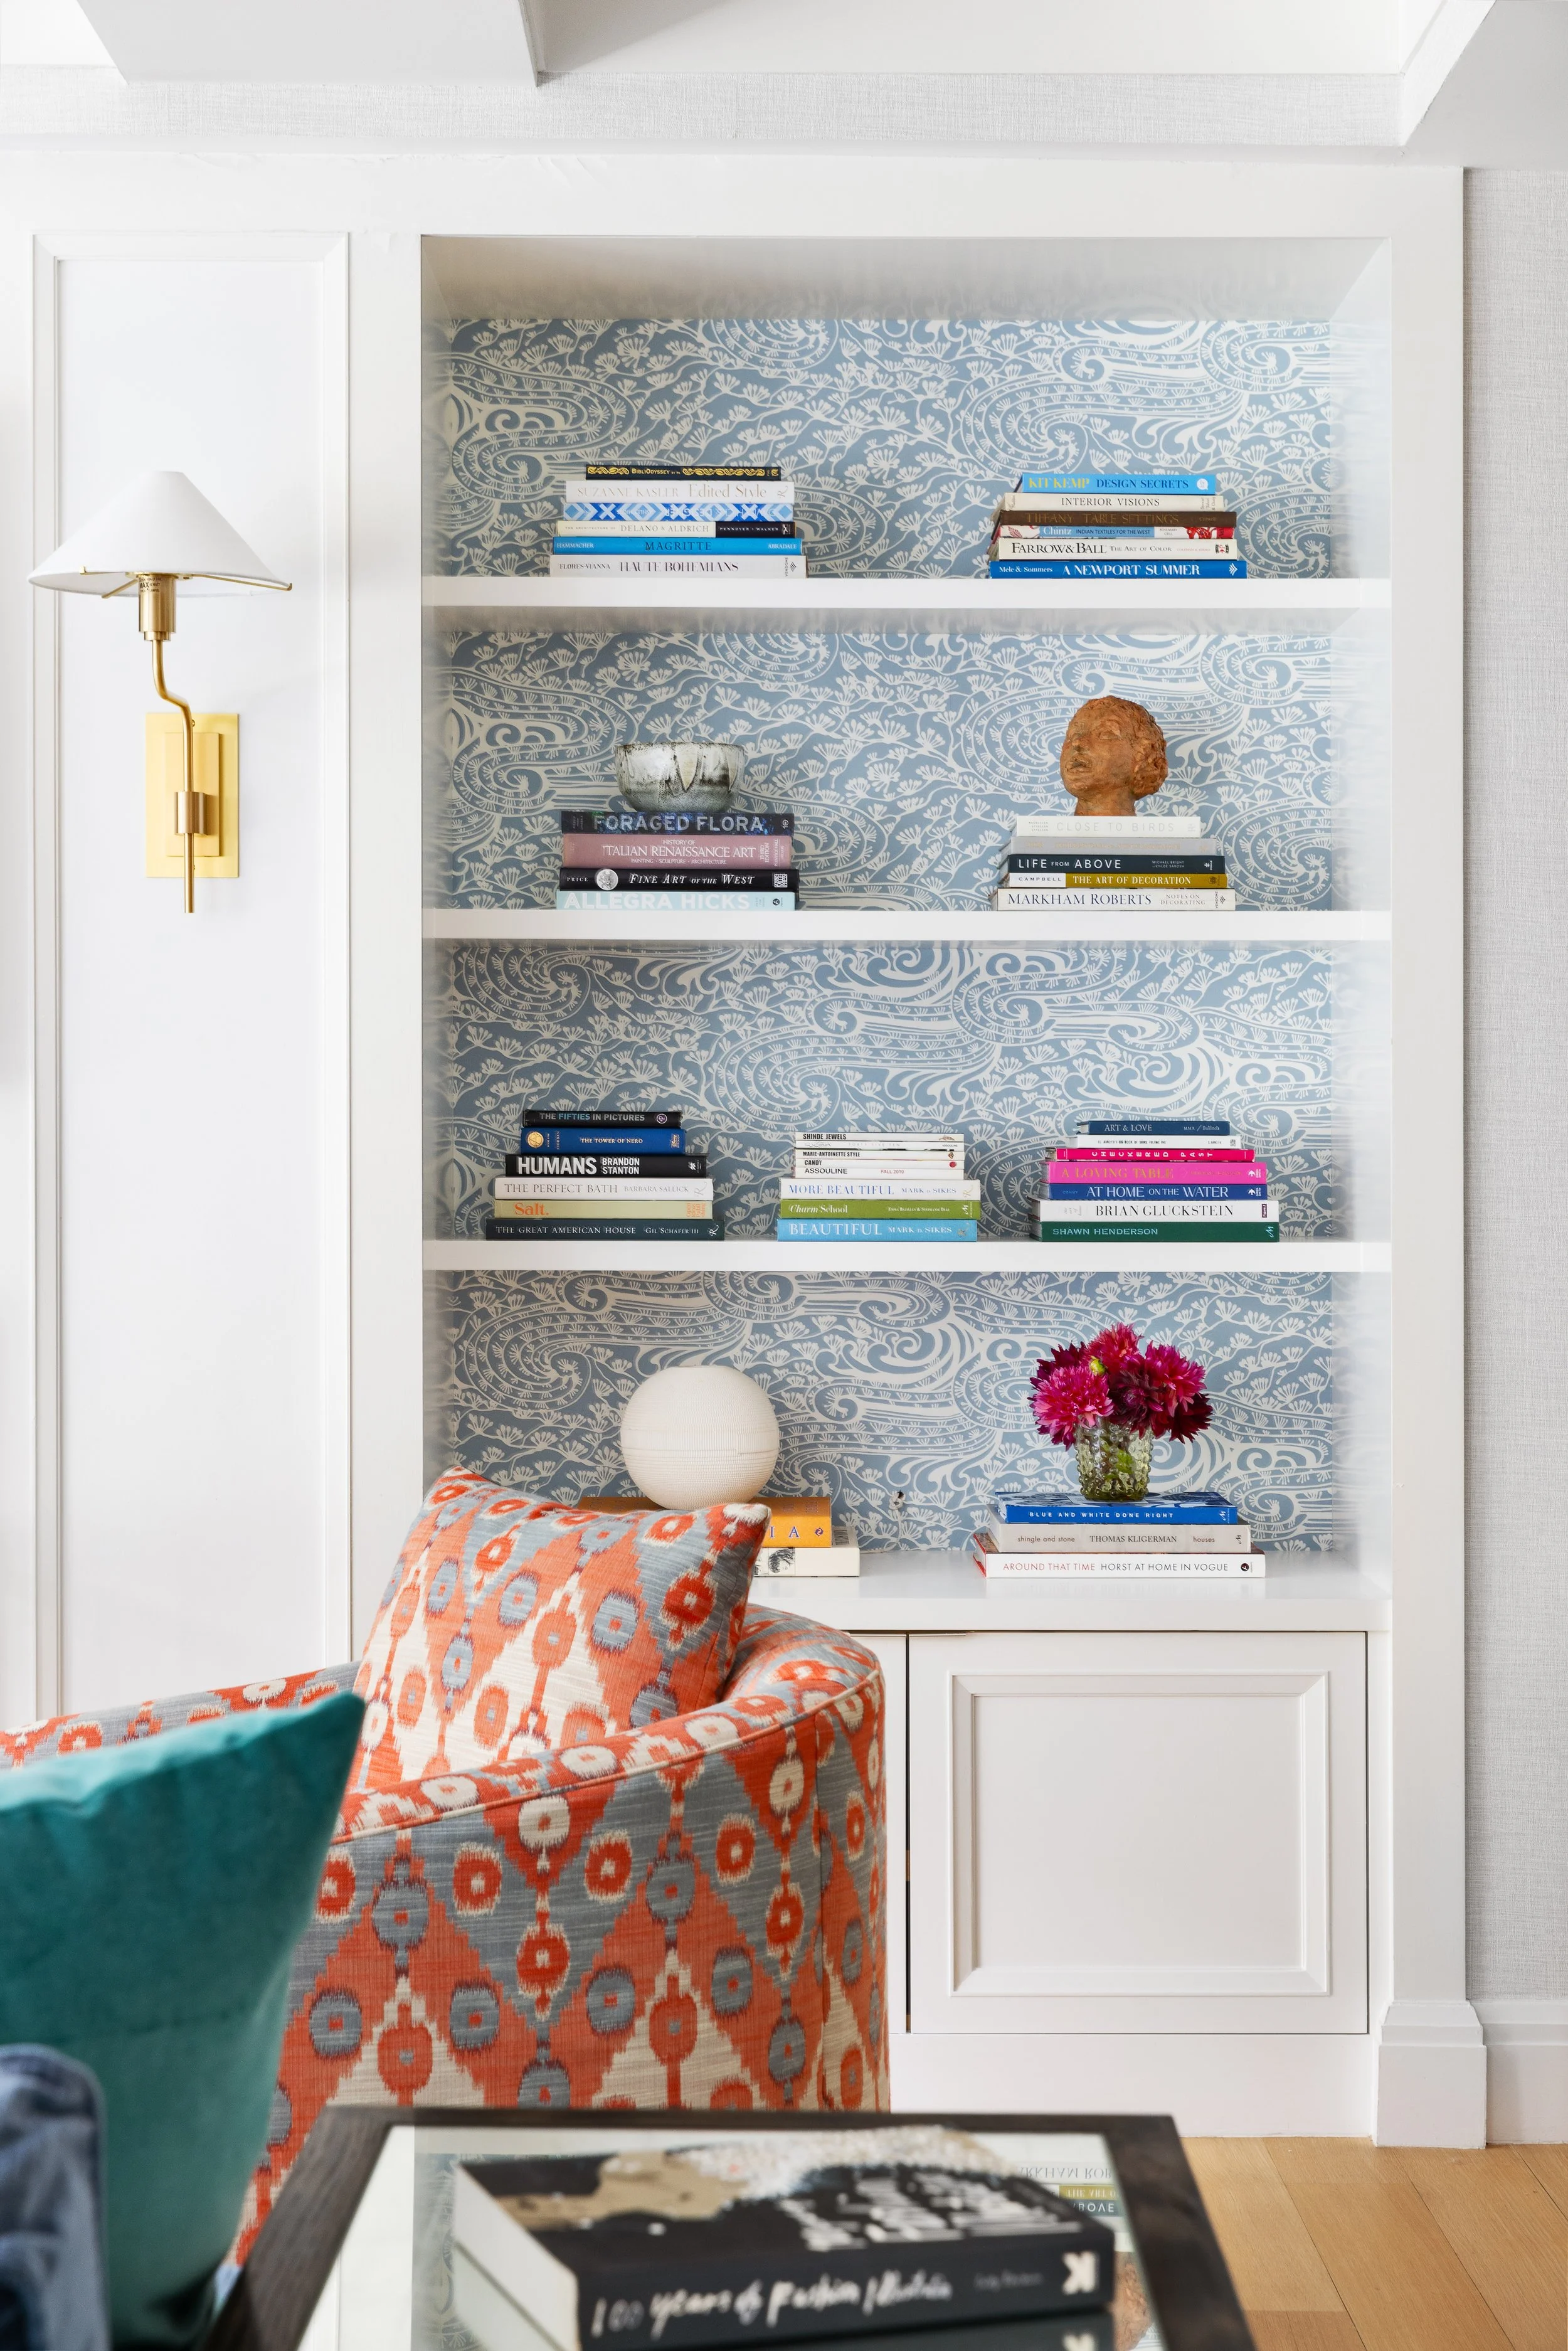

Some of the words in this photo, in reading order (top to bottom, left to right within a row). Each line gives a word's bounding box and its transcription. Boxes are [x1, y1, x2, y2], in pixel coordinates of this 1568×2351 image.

[1029, 477, 1051, 488] KIT
[1053, 477, 1089, 489] KEMP
[1097, 479, 1136, 488] DESIGN
[1140, 479, 1189, 489] SECRETS
[577, 487, 632, 497] SUZANNE
[636, 487, 679, 497] KASLER
[689, 484, 729, 497] Edited
[735, 484, 766, 498] Style
[1062, 497, 1111, 506] INTERIOR
[1117, 497, 1160, 506] VISIONS
[1025, 513, 1074, 523] TIFFANY
[1083, 513, 1117, 524] TABLE
[1121, 514, 1179, 524] SETTINGS
[1043, 526, 1071, 535] Chintz
[645, 541, 712, 551] MAGRITTE
[1012, 542, 1066, 553] FARROW
[1076, 542, 1106, 553] BALL
[619, 561, 660, 571] HAUTE
[665, 561, 739, 572] BOHEMIANS
[1062, 565, 1071, 575] A
[1074, 565, 1142, 575] NEWPORT
[1145, 565, 1200, 575] SUMMER
[594, 815, 689, 831] FORAGED
[696, 816, 764, 832] FLORA
[1057, 822, 1099, 831] CLOSE
[1108, 822, 1123, 832] TO
[1132, 822, 1174, 832] BIRDS
[602, 845, 647, 857] ITALIAN
[651, 846, 730, 857] RENAISSANCE
[733, 847, 756, 858] ART
[1019, 859, 1047, 868] LIFE
[1074, 859, 1121, 869] ABOVE
[1073, 876, 1091, 884] THE
[1095, 876, 1113, 884] ART
[1116, 876, 1129, 884] OF
[1132, 876, 1191, 884] DECORATION
[564, 892, 673, 909] ALLEGRA
[681, 893, 751, 910] HICKS
[1008, 893, 1085, 905] MARKHAM
[1091, 893, 1152, 905] ROBERTS
[517, 1157, 597, 1175] HUMANS
[602, 1157, 640, 1166] BRANDON
[602, 1167, 640, 1175] STANTON
[1061, 1168, 1069, 1178] A
[1074, 1168, 1128, 1179] LOVING
[1132, 1168, 1174, 1179] TABLE
[504, 1184, 528, 1192] THE
[533, 1184, 583, 1193] PERFECT
[587, 1184, 617, 1193] BATH
[788, 1184, 823, 1194] MORE
[827, 1185, 894, 1195] BEAUTIFUL
[1086, 1186, 1103, 1197] AT
[1106, 1186, 1145, 1197] HOME
[1183, 1186, 1229, 1197] WATER
[514, 1202, 549, 1216] Salt.
[788, 1204, 818, 1213] Charm
[820, 1204, 848, 1213] School
[1096, 1205, 1138, 1216] BRIAN
[1143, 1205, 1234, 1216] GLUCKSTEIN
[518, 1226, 549, 1234] GREAT
[788, 1223, 882, 1235] BEAUTIFUL
[1017, 1536, 1041, 1544] shingle
[1004, 1563, 1045, 1571] AROUND
[1048, 1563, 1071, 1571] THAT
[1073, 1563, 1096, 1571] TIME
[1101, 1563, 1131, 1571] HORST
[1135, 1563, 1145, 1571] AT
[1148, 1563, 1177, 1571] HOME
[1180, 1563, 1191, 1571] IN
[1194, 1563, 1228, 1571] VOGUE
[590, 2297, 645, 2340] 100
[649, 2289, 733, 2341] years
